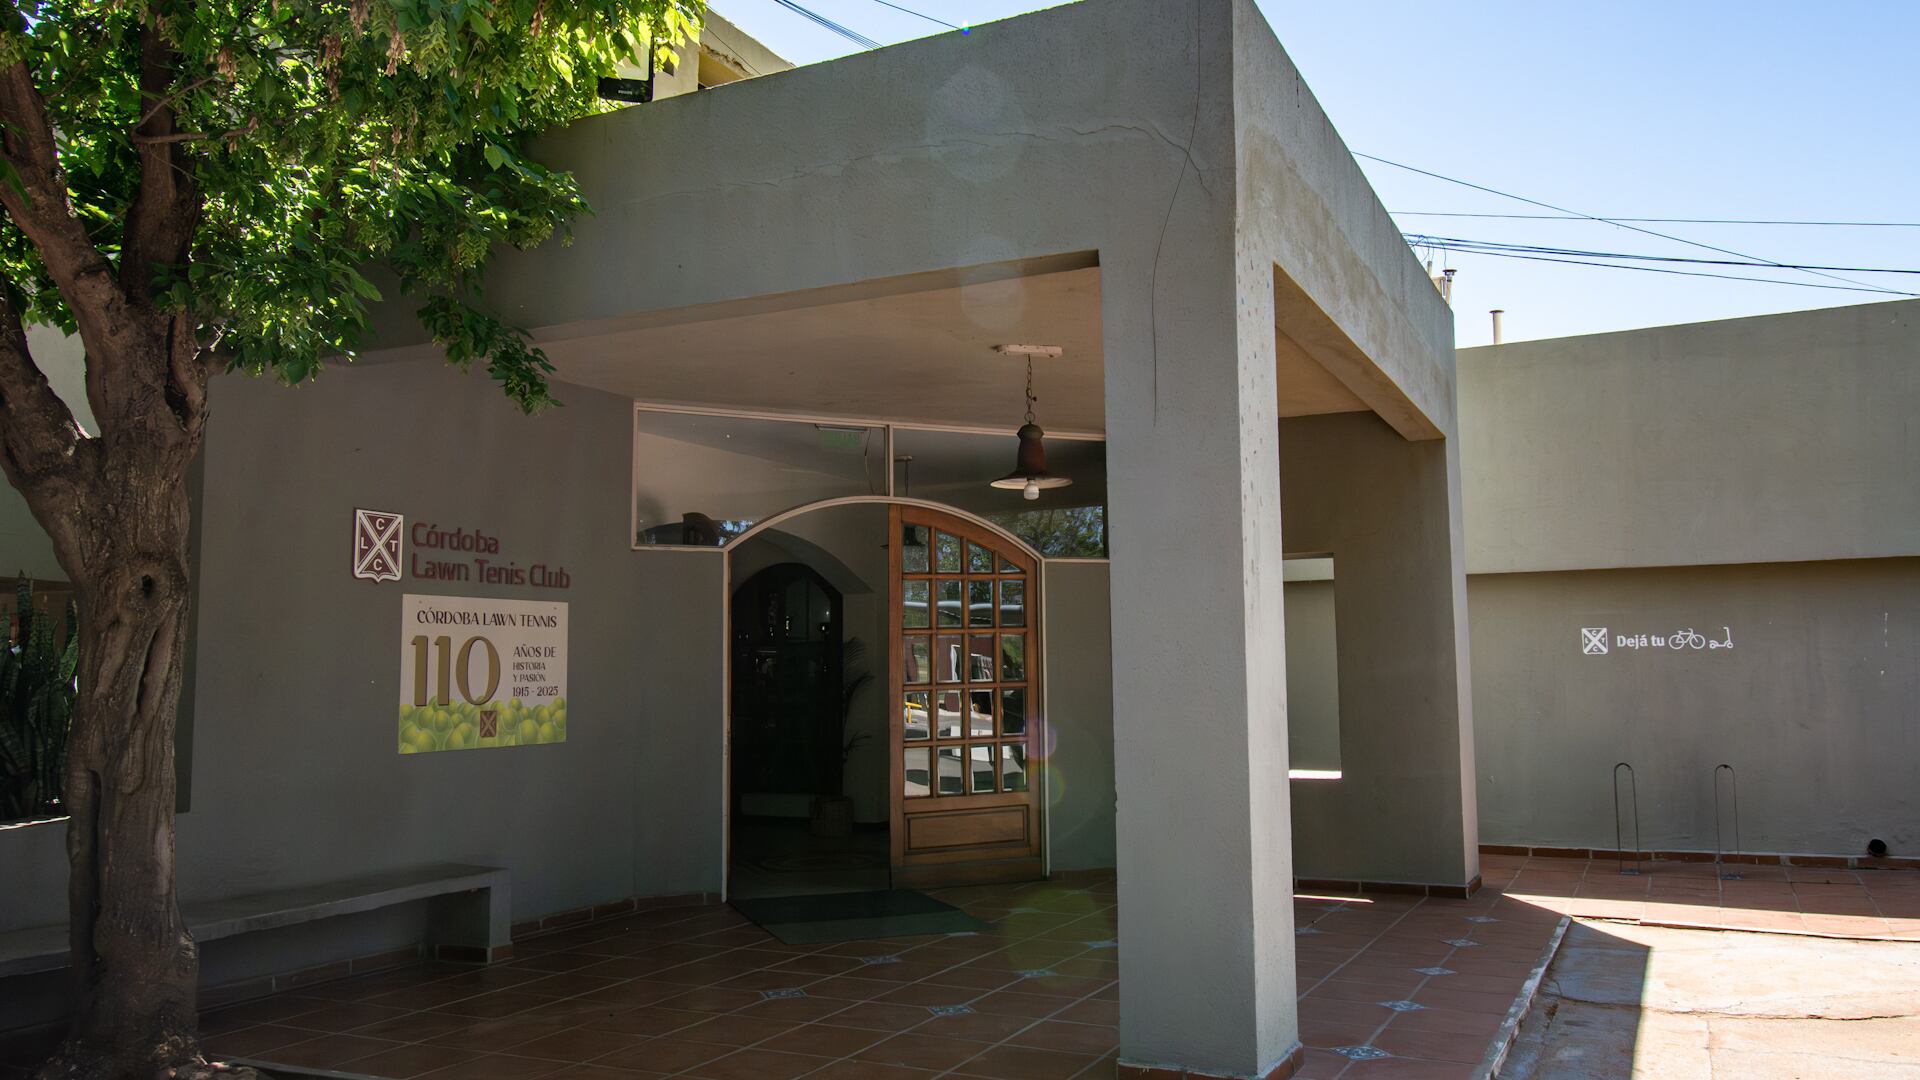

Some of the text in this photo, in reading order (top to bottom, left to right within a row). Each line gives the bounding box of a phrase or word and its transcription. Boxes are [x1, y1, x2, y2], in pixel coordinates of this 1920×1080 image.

[375, 518, 385, 530] C
[361, 536, 398, 552] L T
[411, 522, 500, 555] Córdoba
[373, 559, 383, 571] C
[411, 552, 571, 589] Lawn Tenis Club
[417, 607, 558, 628] CÓRDOBA LAWN TENNIS
[1616, 634, 1665, 650] Dejá tu
[512, 643, 557, 659] AÑOS DE
[410, 634, 501, 707] 110
[512, 661, 546, 671] HISTORIA
[512, 672, 546, 683] Y PASIÓN
[512, 686, 530, 698] 1915
[537, 685, 559, 697] 2025
